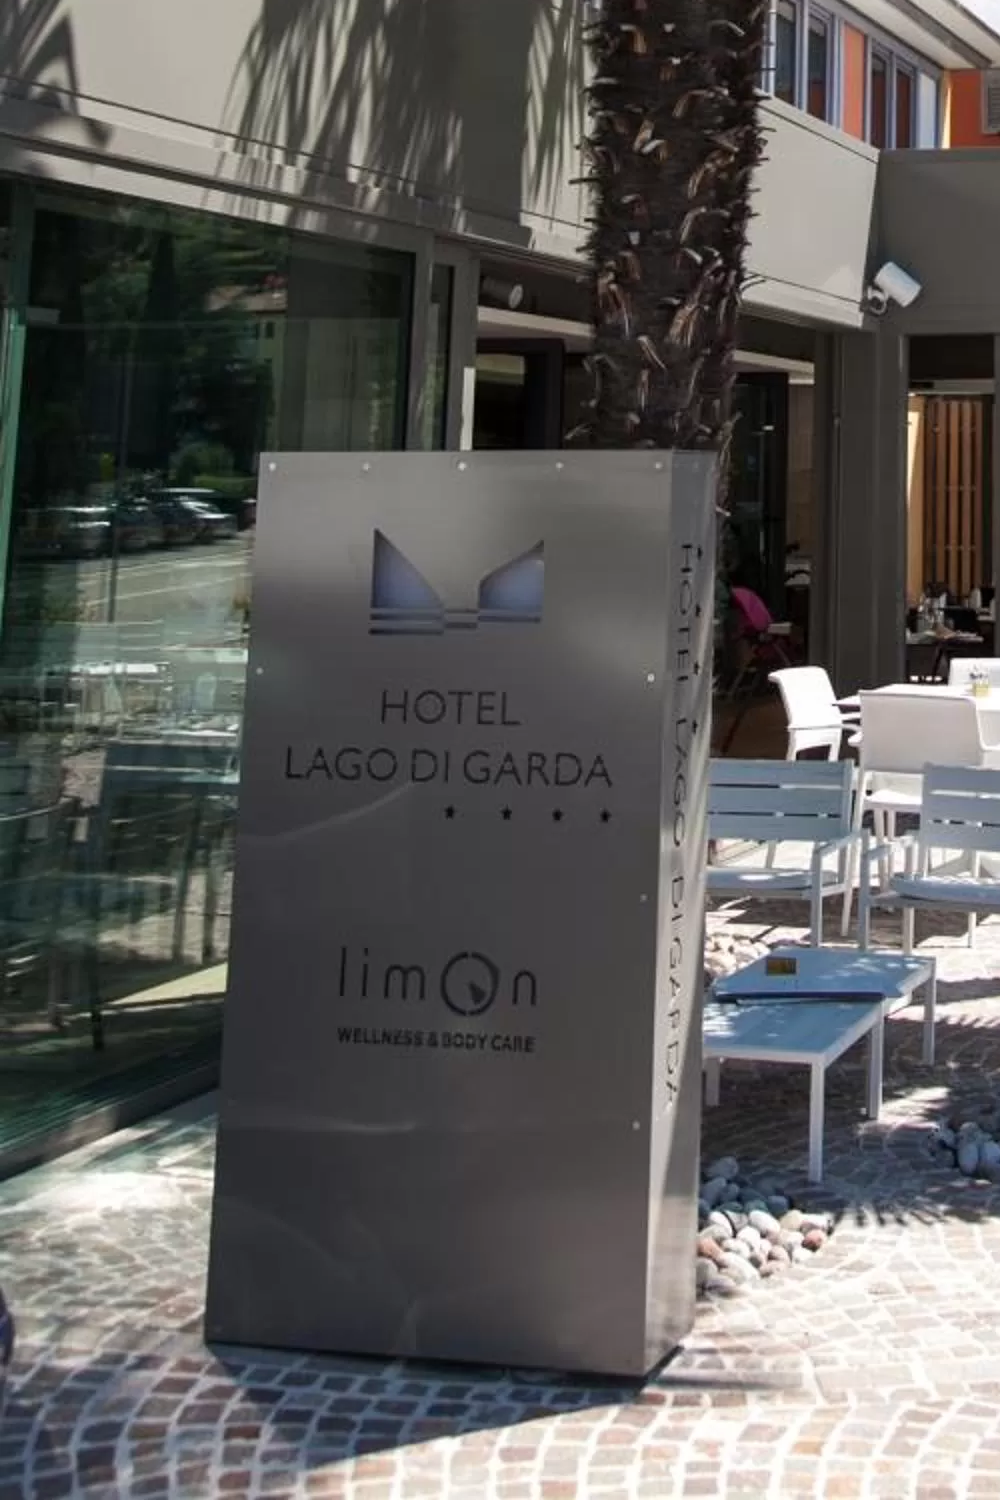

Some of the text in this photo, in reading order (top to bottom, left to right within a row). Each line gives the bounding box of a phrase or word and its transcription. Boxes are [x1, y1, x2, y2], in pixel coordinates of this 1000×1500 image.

[676, 543, 693, 692] HOTEL
[380, 688, 522, 726] HOTEL
[284, 745, 613, 789] LAGO DI GARDA
[337, 1026, 425, 1048] WELLNESS
[441, 1031, 488, 1051] BODY
[490, 1033, 536, 1053] CARE
